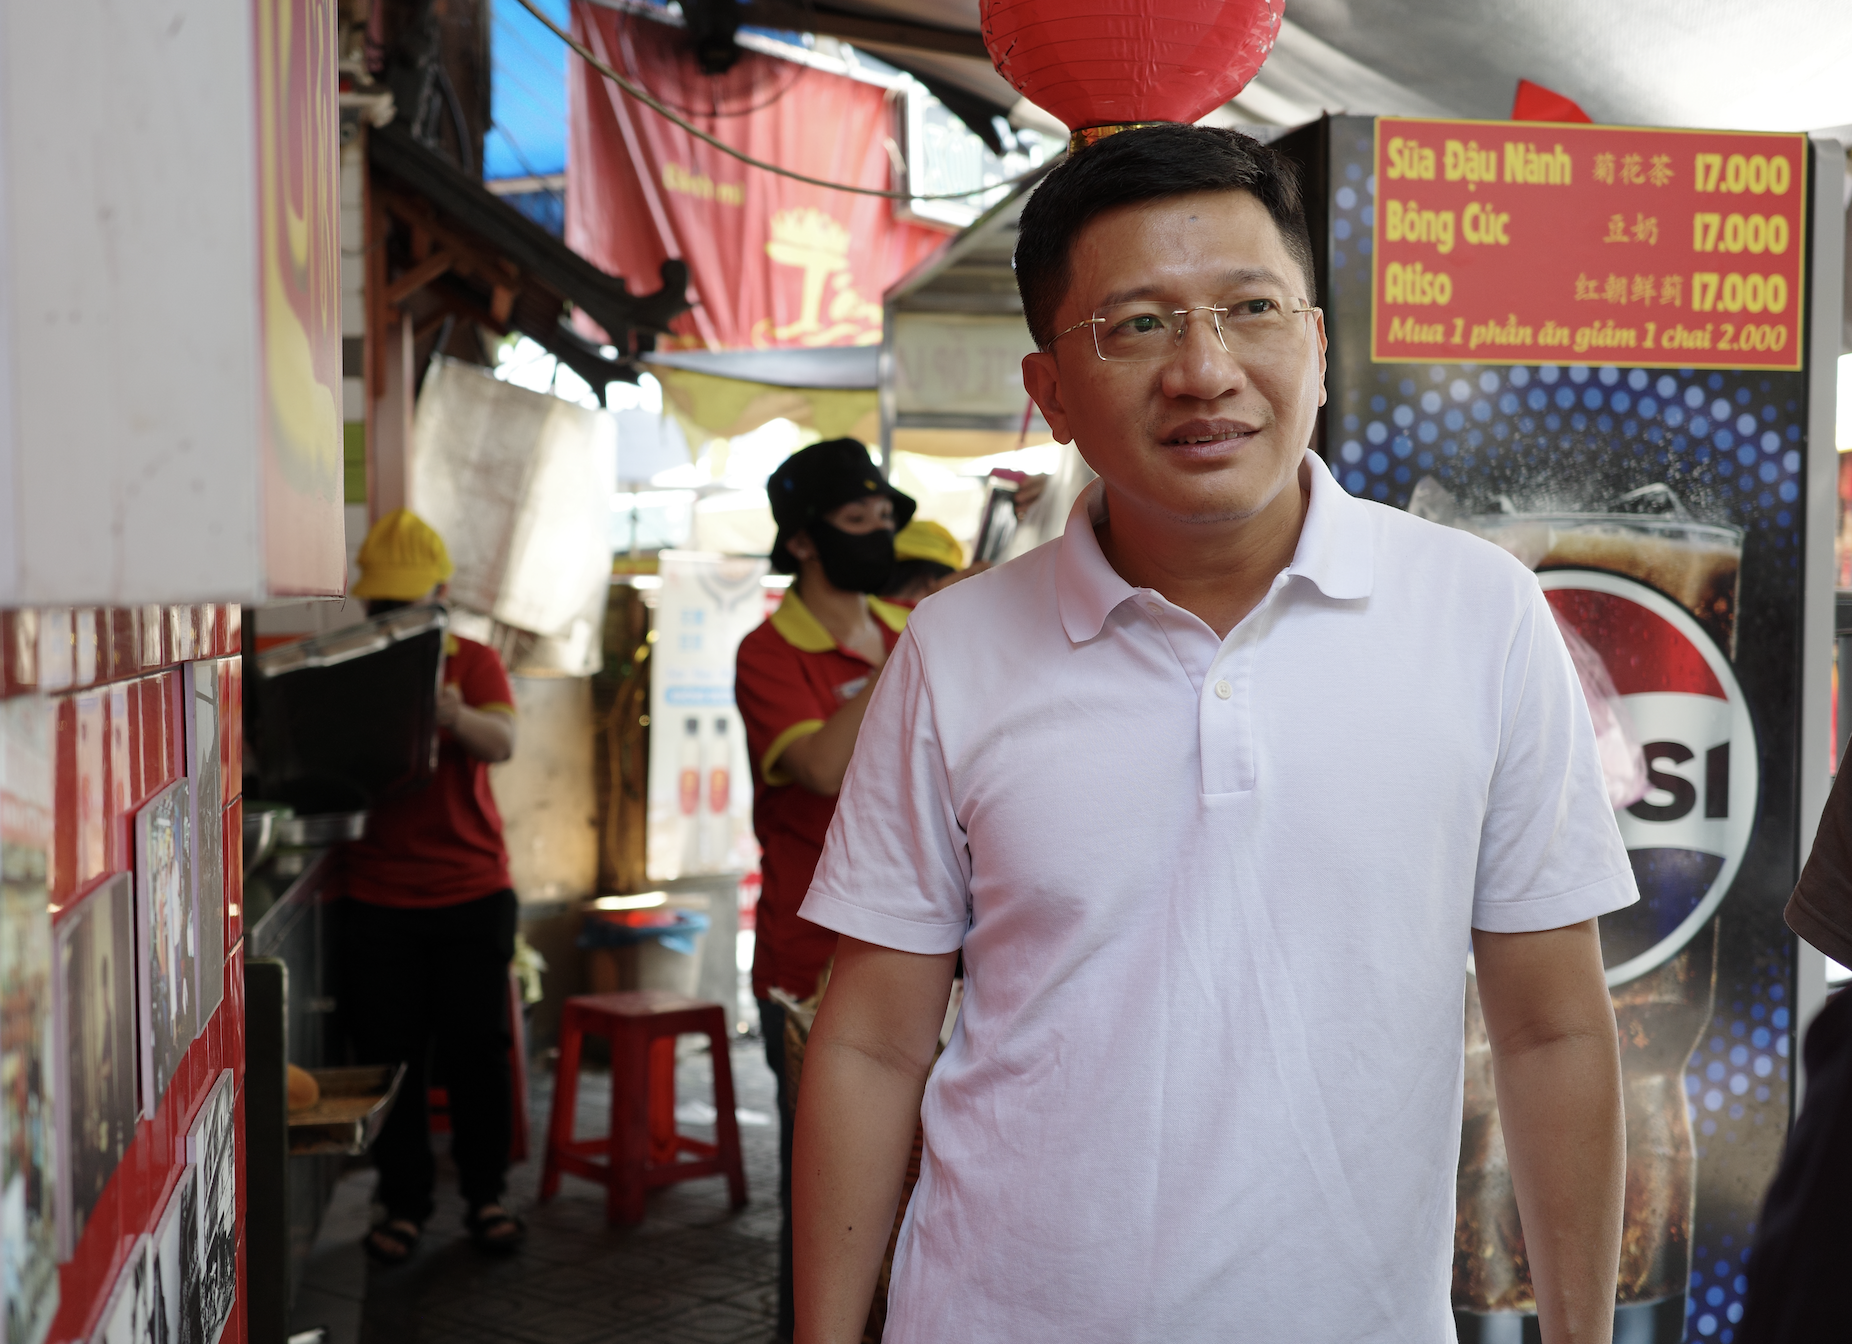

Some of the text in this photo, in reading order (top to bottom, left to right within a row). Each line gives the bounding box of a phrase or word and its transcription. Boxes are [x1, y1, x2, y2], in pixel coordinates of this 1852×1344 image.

[1443, 140, 1497, 192] Đậu
[1504, 141, 1572, 186] Nành
[1592, 152, 1676, 187] 菊花茶
[1694, 153, 1791, 196] 17.000
[1385, 199, 1789, 255] Bông Cúc 豆奶 17.000
[1384, 261, 1453, 306] Atiso
[1691, 272, 1788, 315] 17.000
[1388, 315, 1445, 344] Mua
[1450, 317, 1465, 345] 1
[1537, 320, 1571, 347] ăn
[1642, 321, 1657, 349] 1
[1661, 323, 1713, 350] chai
[1717, 323, 1787, 352] 2.000
